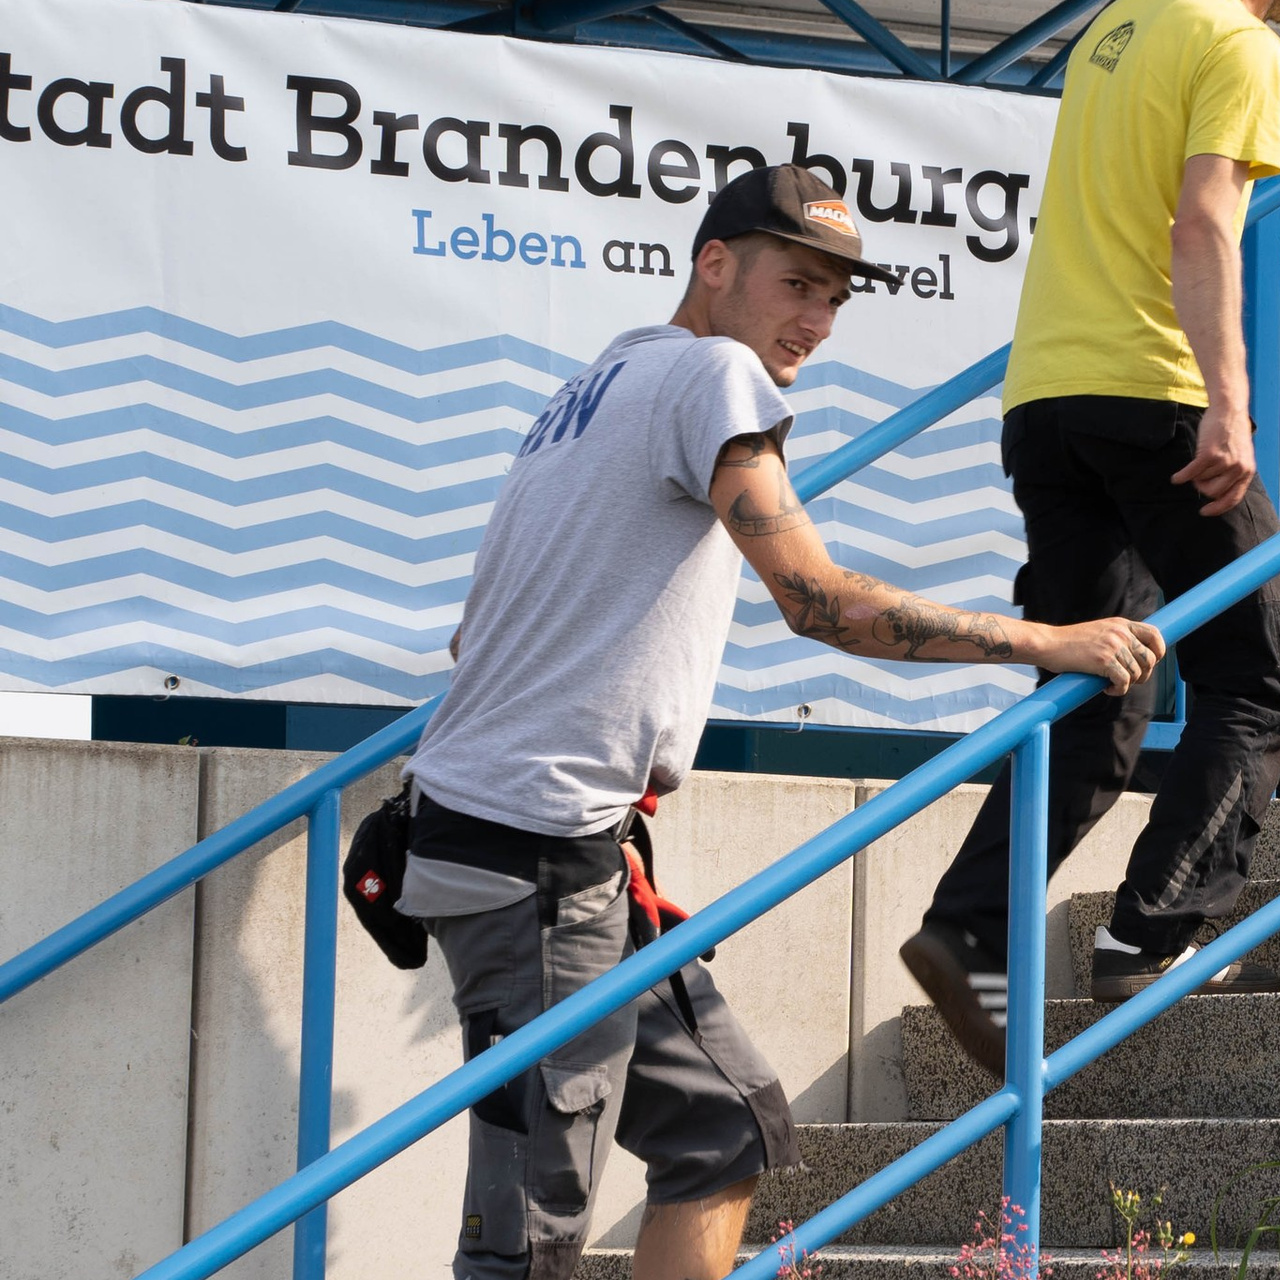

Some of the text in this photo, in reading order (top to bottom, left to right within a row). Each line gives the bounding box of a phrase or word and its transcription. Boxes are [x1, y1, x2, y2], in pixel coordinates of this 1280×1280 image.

[0, 52, 248, 162] tadt
[411, 209, 955, 300] Leben an avel
